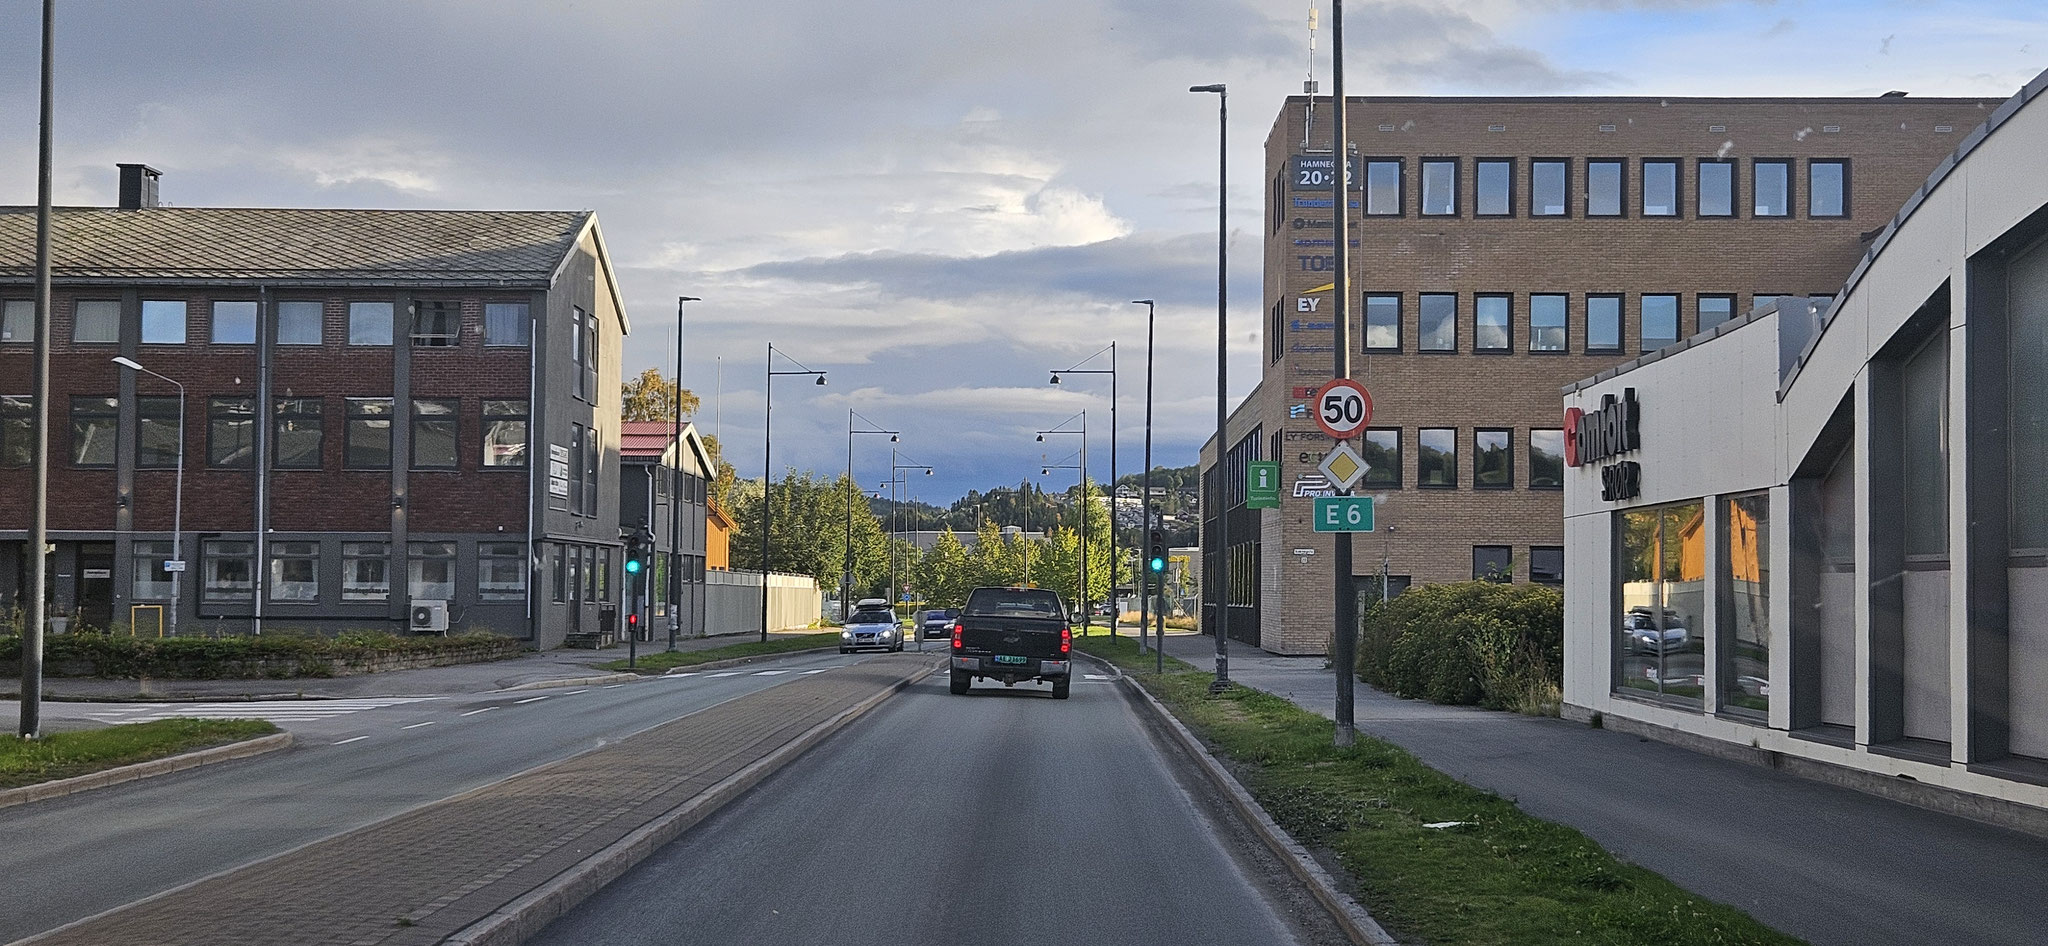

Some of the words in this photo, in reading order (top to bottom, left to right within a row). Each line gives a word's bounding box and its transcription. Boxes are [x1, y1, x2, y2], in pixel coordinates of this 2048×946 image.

[1298, 297, 1320, 312] EY
[1324, 395, 1363, 424] 50
[1564, 388, 1640, 467] Comfort
[1327, 504, 1340, 524] E
[1347, 504, 1361, 524] 6
